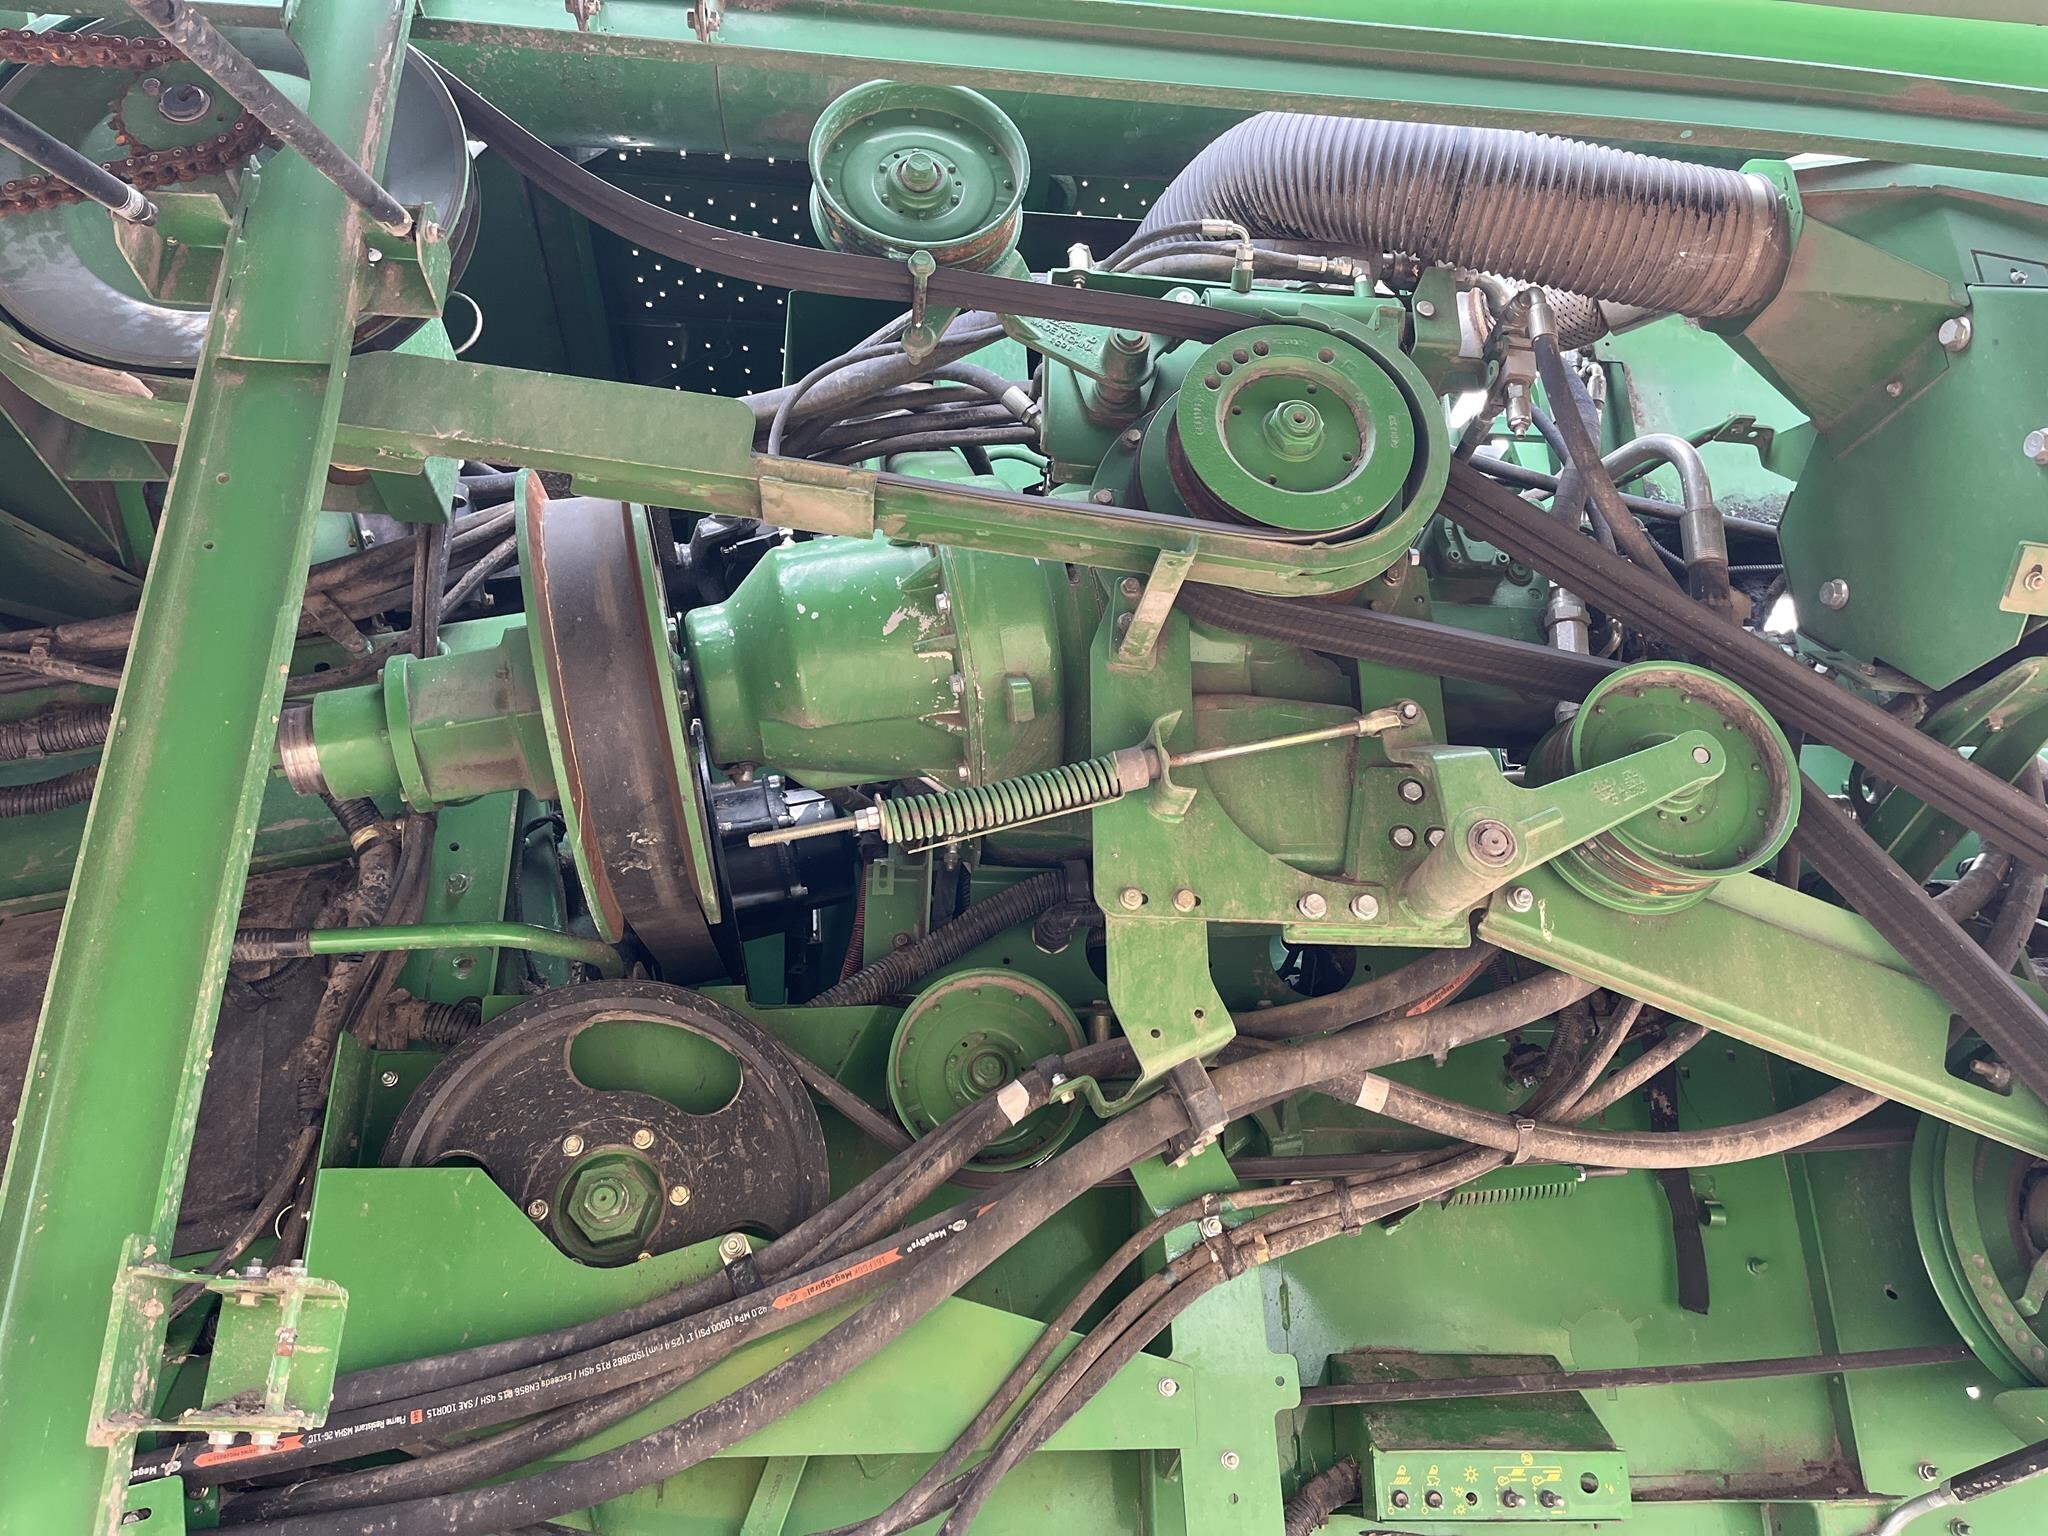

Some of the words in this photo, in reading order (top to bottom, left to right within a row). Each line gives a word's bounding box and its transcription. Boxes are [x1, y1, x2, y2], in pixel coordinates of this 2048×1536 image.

[1030, 320, 1058, 336] MADE
[1067, 336, 1094, 354] CHINA
[734, 1311, 751, 1324] MPa
[750, 1305, 768, 1318] 42.0
[695, 1325, 712, 1340] PSI)
[595, 1359, 612, 1373] R15
[541, 1371, 572, 1388] Exceeds
[497, 1388, 513, 1401] R15
[514, 1383, 541, 1398] EN856
[426, 1403, 457, 1419] 100R15
[458, 1399, 474, 1412] SAE
[355, 1419, 386, 1433] Resistant
[385, 1414, 407, 1427] Flame
[334, 1426, 354, 1439] MSHA
